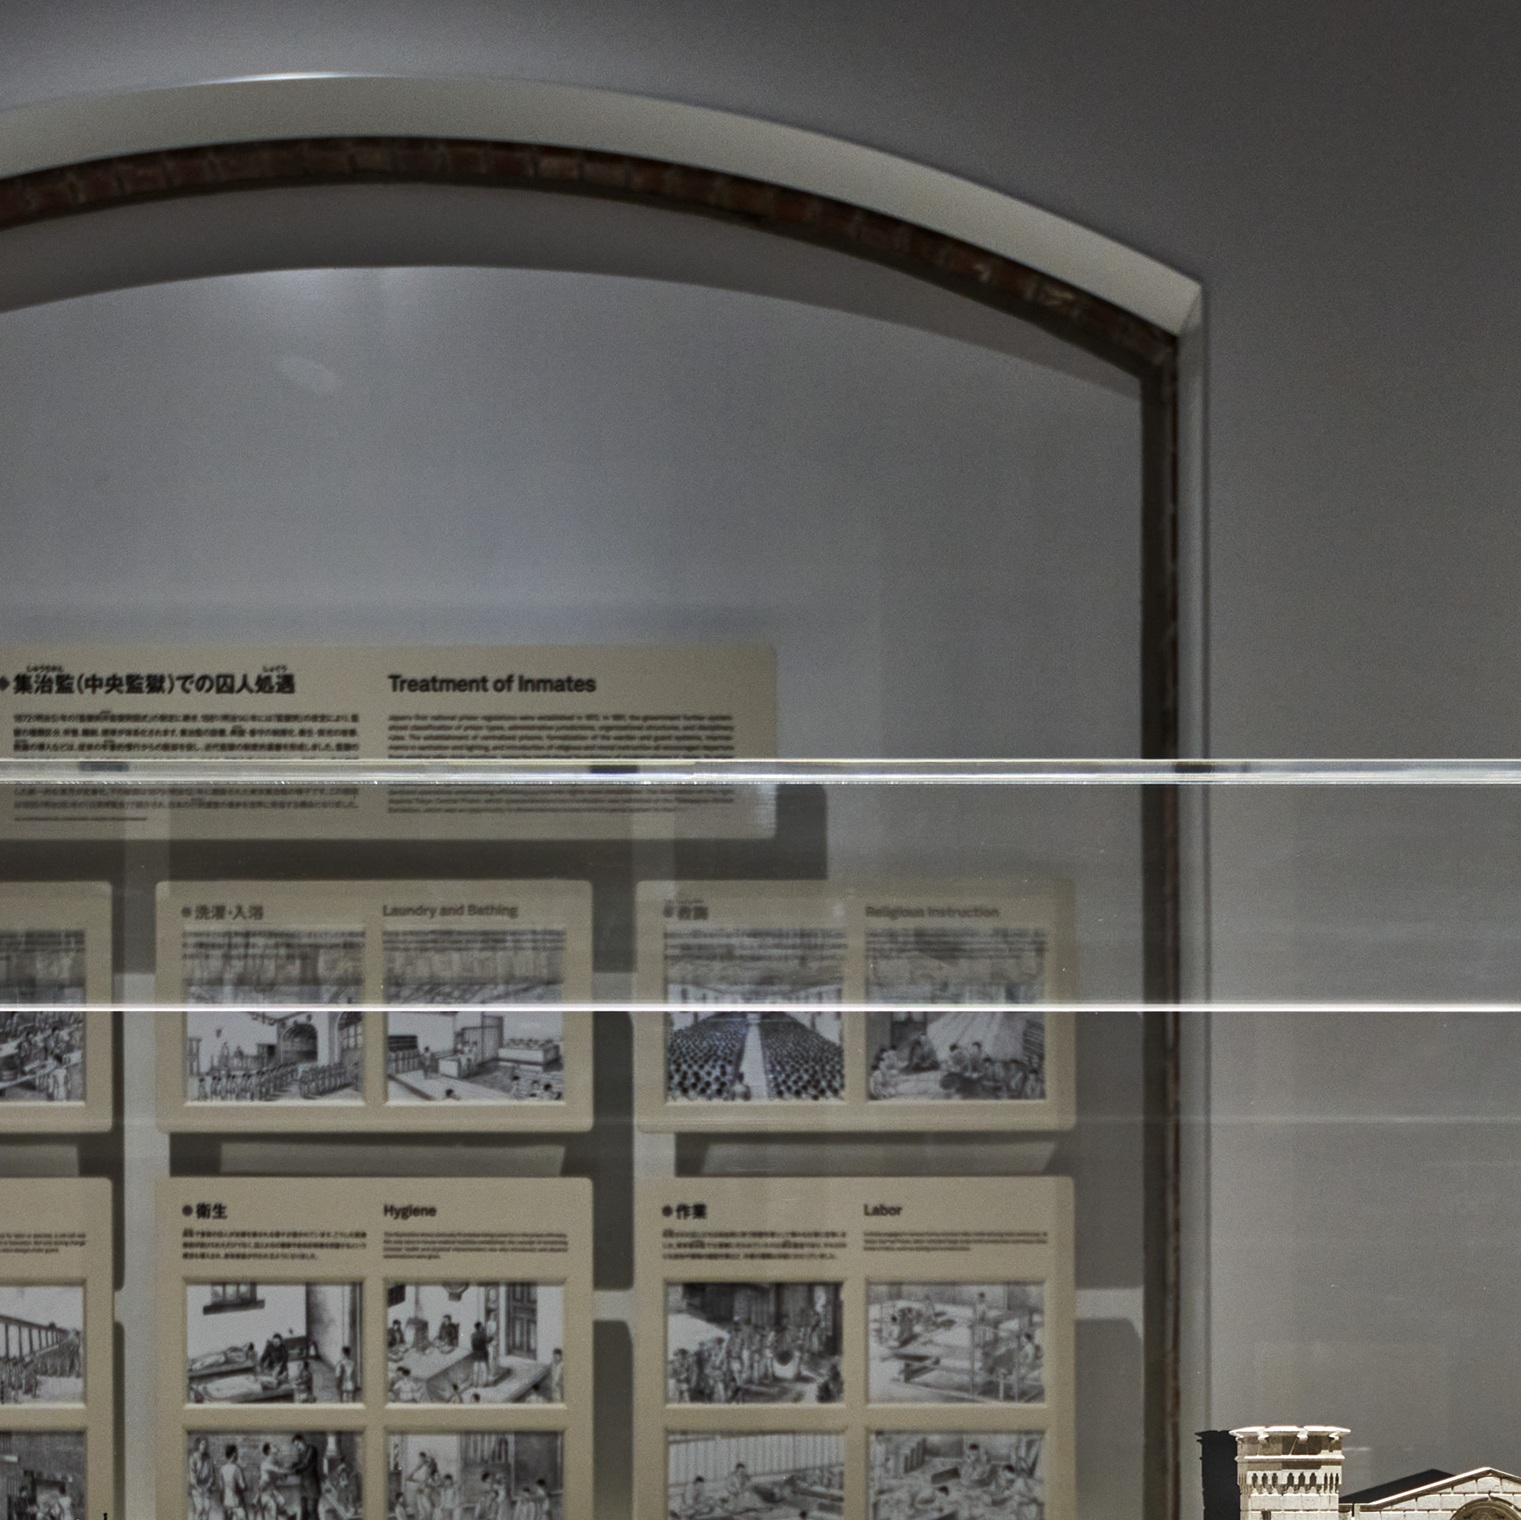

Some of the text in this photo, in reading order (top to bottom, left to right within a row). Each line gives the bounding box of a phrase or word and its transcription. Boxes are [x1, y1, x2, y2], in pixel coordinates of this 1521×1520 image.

[388, 674, 596, 693] Treatment of Inmates
[383, 903, 518, 919] Laundry and Bathing
[865, 905, 1000, 920] Religious Instruction
[383, 1204, 437, 1219] Hygiene
[863, 1202, 903, 1216] Labor
